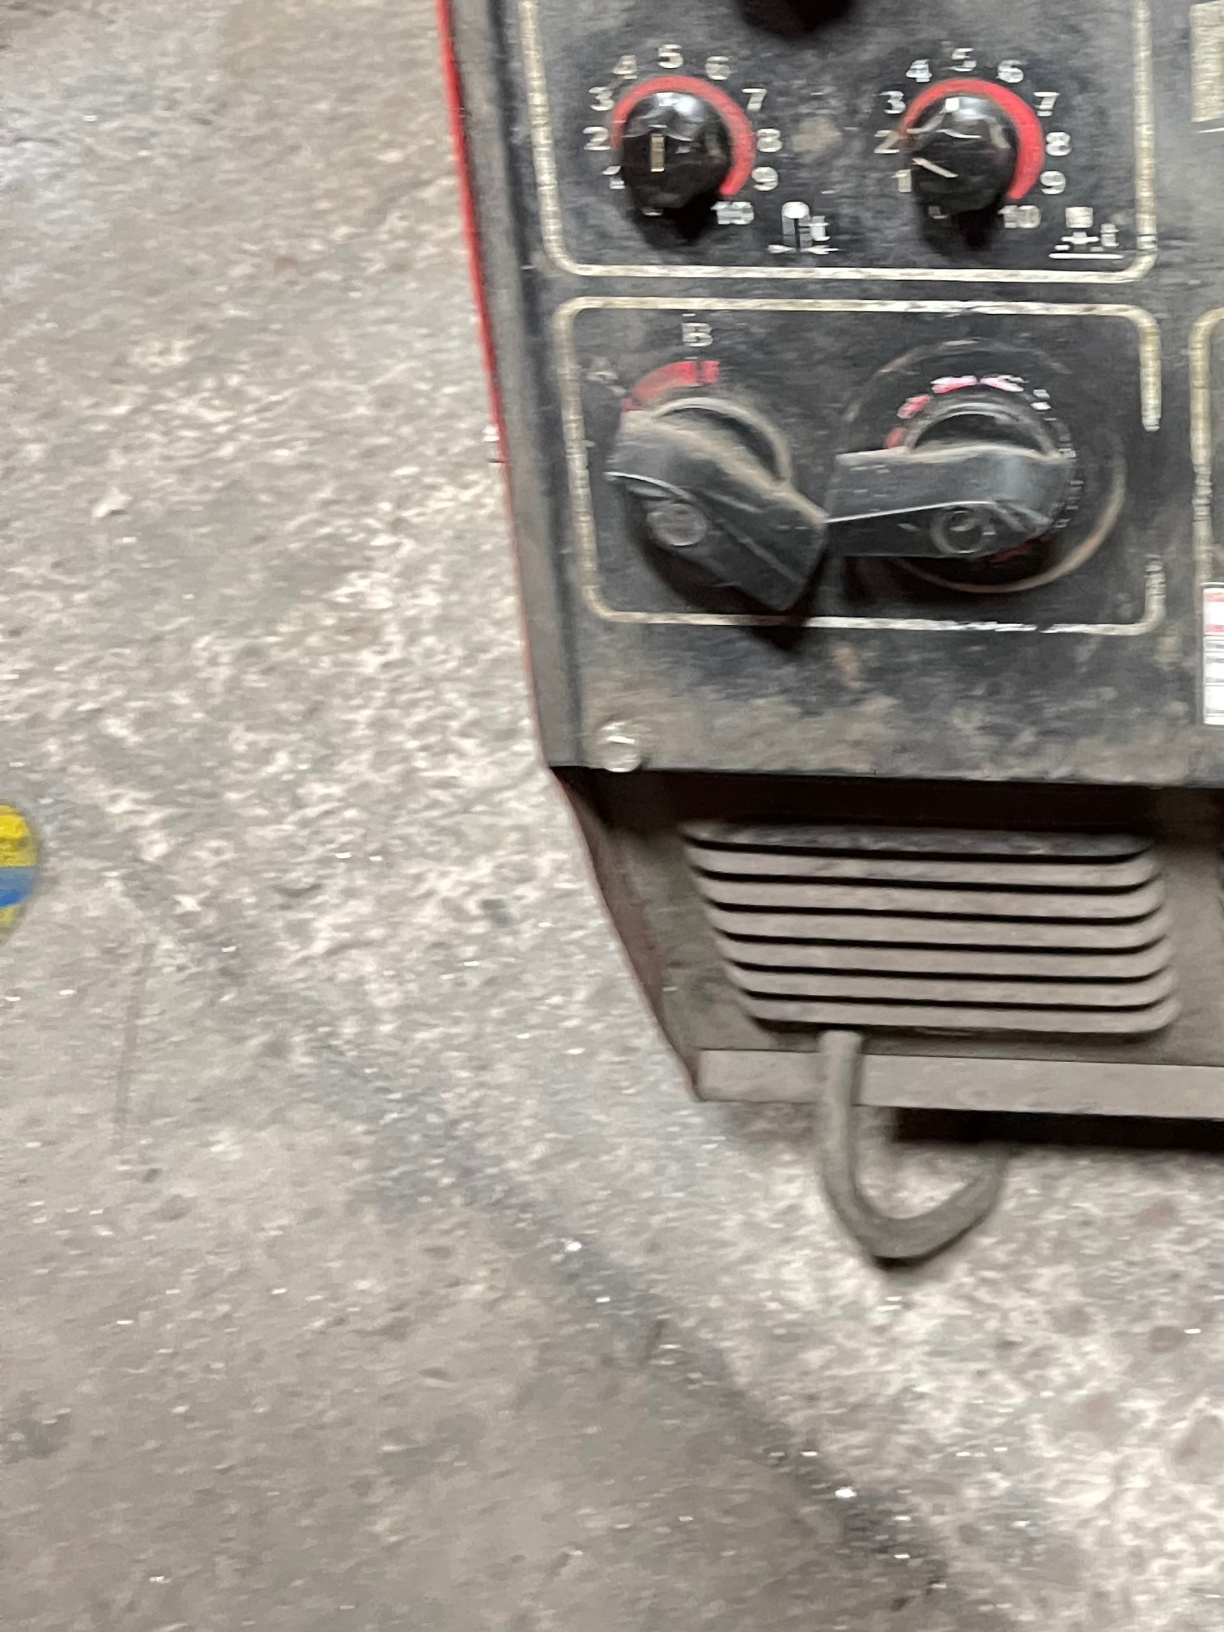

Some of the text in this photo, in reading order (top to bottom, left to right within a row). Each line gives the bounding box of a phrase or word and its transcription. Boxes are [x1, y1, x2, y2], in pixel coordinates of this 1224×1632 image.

[612, 55, 638, 80] 4
[658, 43, 684, 69] 5
[705, 56, 732, 81] 6
[951, 47, 977, 72] 5
[905, 59, 932, 83] 4
[997, 59, 1024, 84] 6
[588, 86, 615, 112] 3
[741, 88, 768, 112] 7
[880, 90, 907, 115] 3
[1032, 91, 1060, 117] 7
[582, 126, 612, 151] 2
[756, 128, 783, 153] 8
[874, 129, 904, 154] 2
[1045, 131, 1073, 157] 8
[751, 166, 779, 191] 9
[1039, 170, 1067, 195] 9
